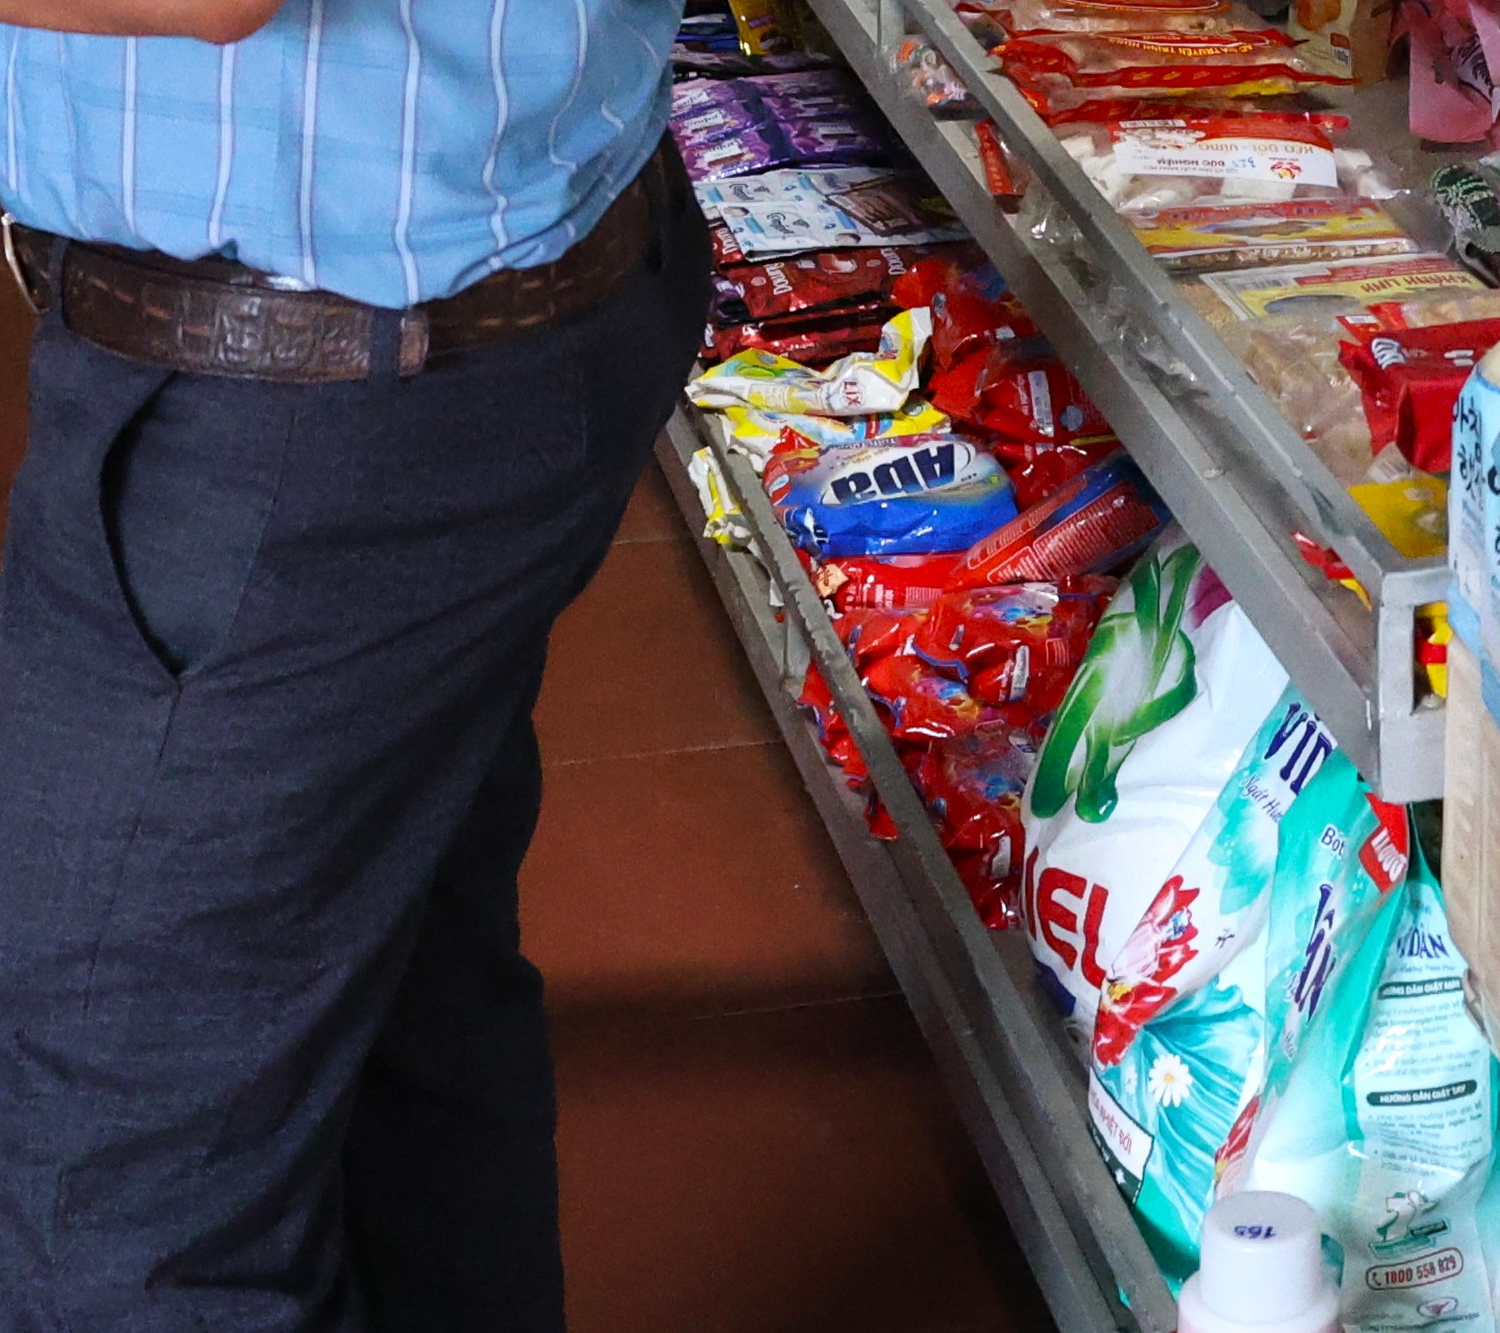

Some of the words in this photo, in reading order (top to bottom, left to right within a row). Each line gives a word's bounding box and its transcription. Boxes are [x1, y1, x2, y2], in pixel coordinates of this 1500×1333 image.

[843, 380, 862, 407] LIX
[831, 443, 954, 505] Aba
[1385, 1268, 1413, 1285] 1800
[1439, 1255, 1456, 1272] 829
